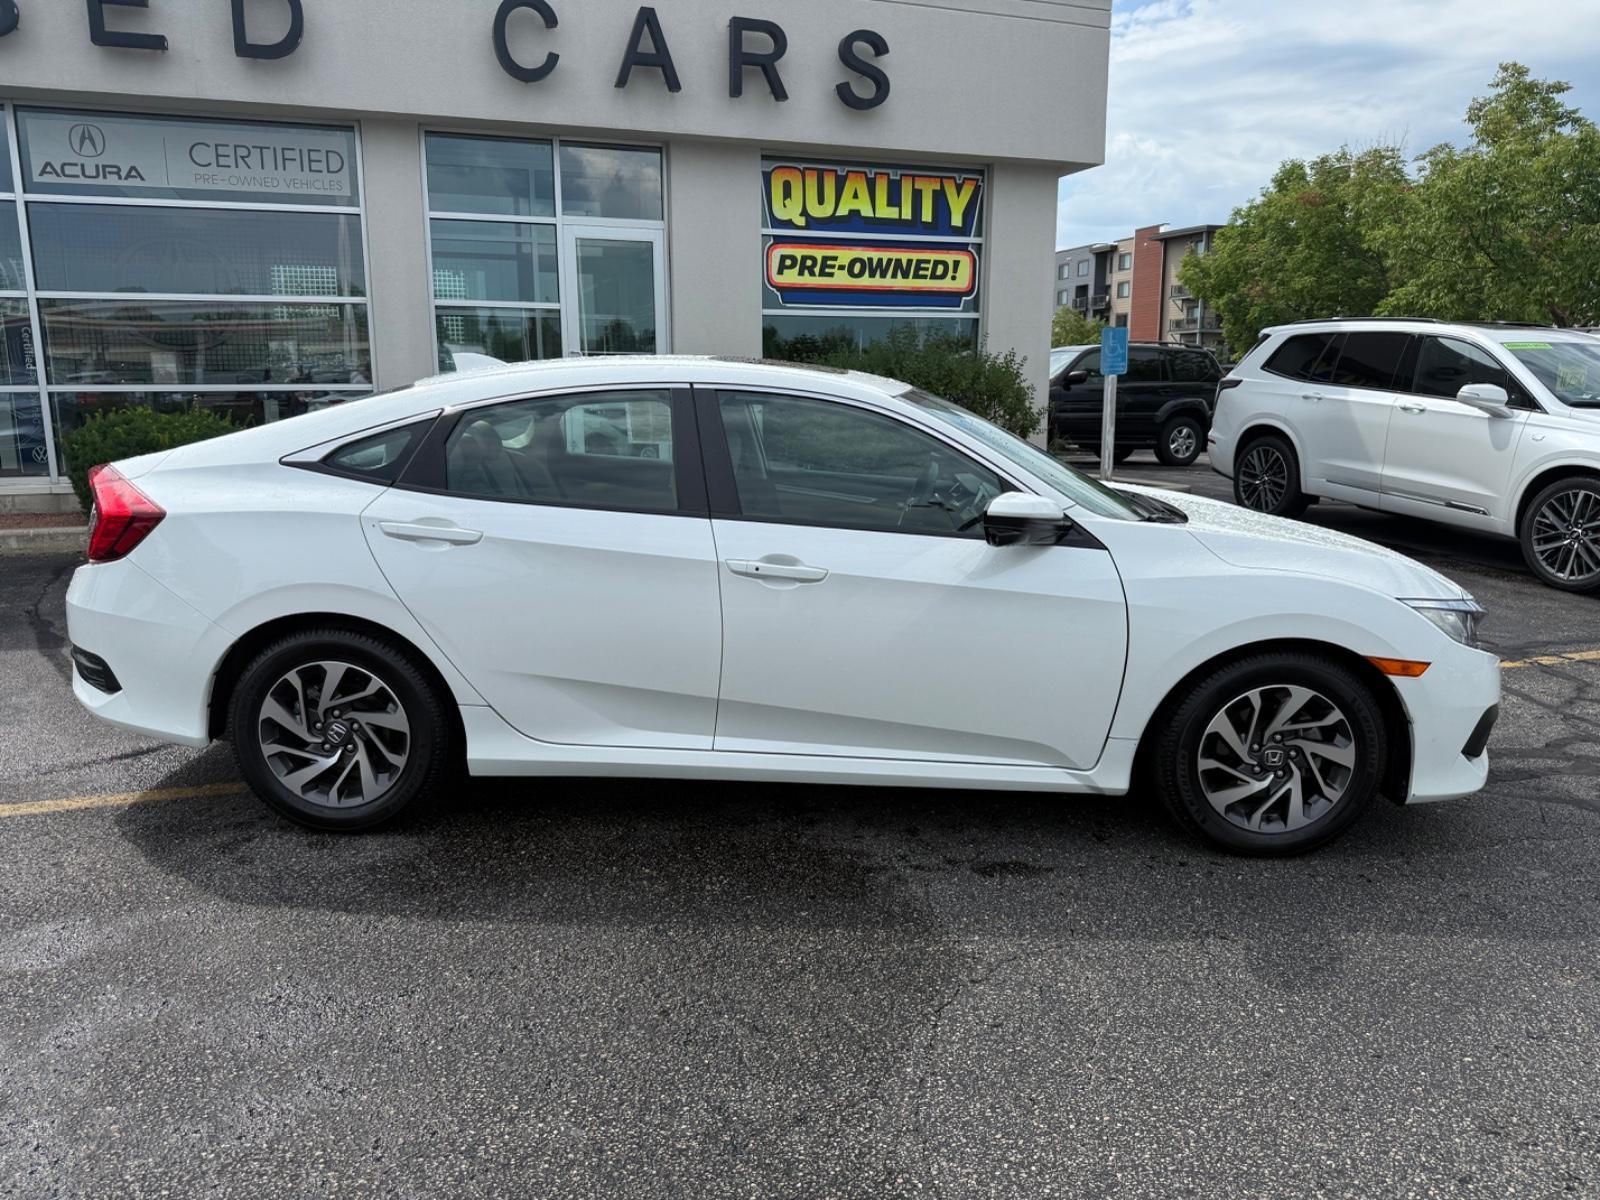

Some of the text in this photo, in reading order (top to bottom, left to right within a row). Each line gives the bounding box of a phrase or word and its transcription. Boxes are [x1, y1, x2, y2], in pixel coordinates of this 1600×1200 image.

[492, 0, 892, 110] CARS
[38, 160, 146, 181] ACURA
[188, 142, 345, 174] CERTIFIED
[194, 173, 344, 192] PRE-OWNED VEHICLES
[770, 165, 977, 228] QUALITY
[776, 253, 961, 282] PRE-OWNED!
